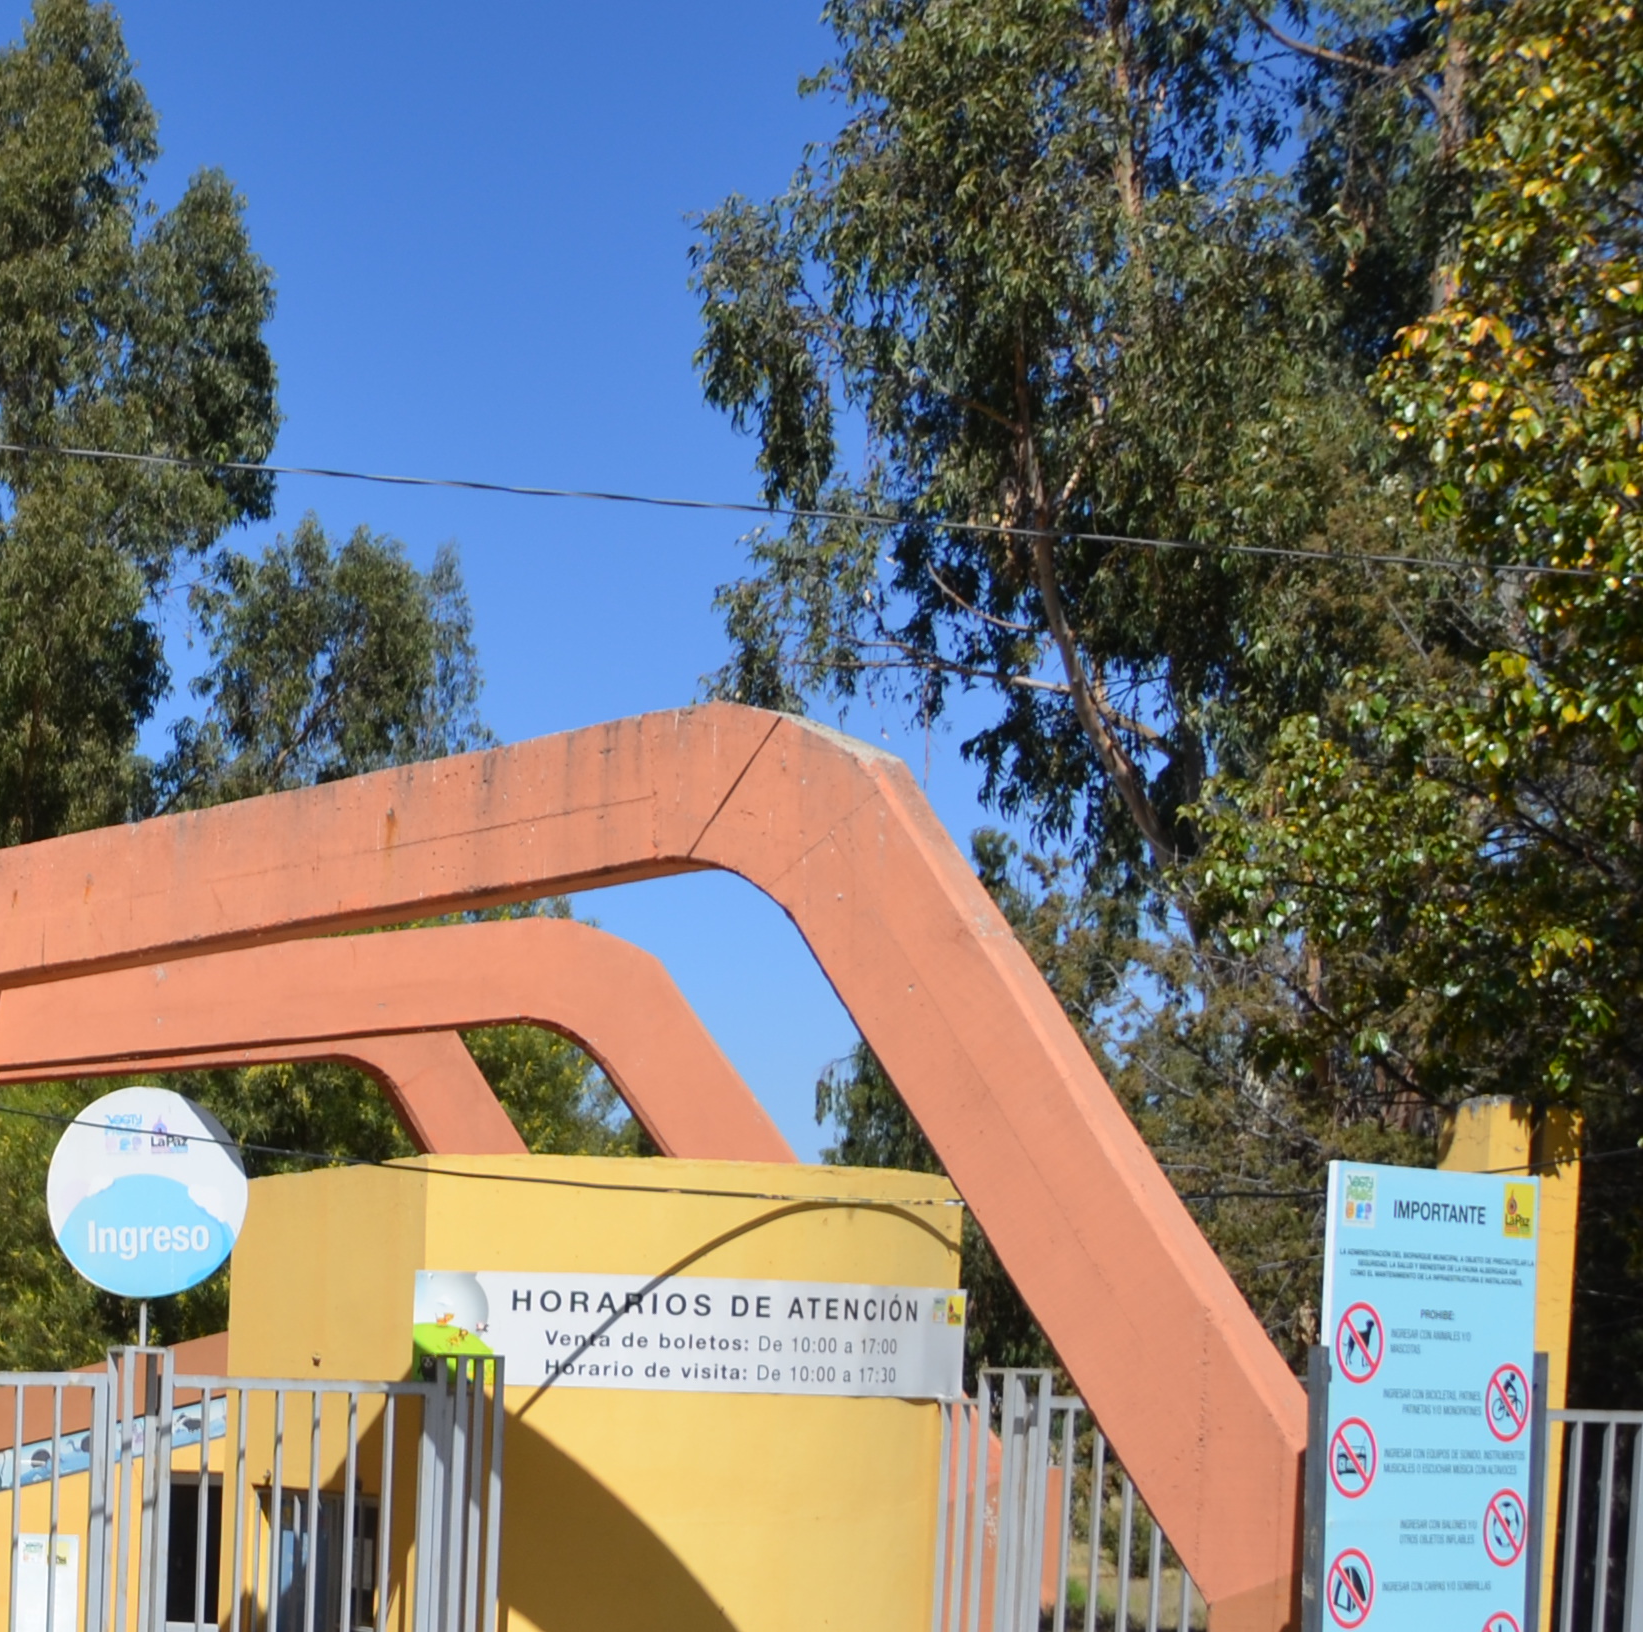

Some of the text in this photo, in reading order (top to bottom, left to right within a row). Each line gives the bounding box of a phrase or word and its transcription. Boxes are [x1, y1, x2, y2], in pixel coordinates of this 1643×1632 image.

[1393, 1200, 1486, 1225] IMPORTANTE
[88, 1220, 210, 1261] Ingreso
[512, 1289, 712, 1316] HORARIOS
[731, 1295, 771, 1318] DE
[787, 1294, 918, 1322] ATENCIÓN
[545, 1330, 898, 1355] Venta de boletos: De 10:00 a 17:00
[545, 1359, 896, 1383] Horario de visita: De 10:00 a 17:30
